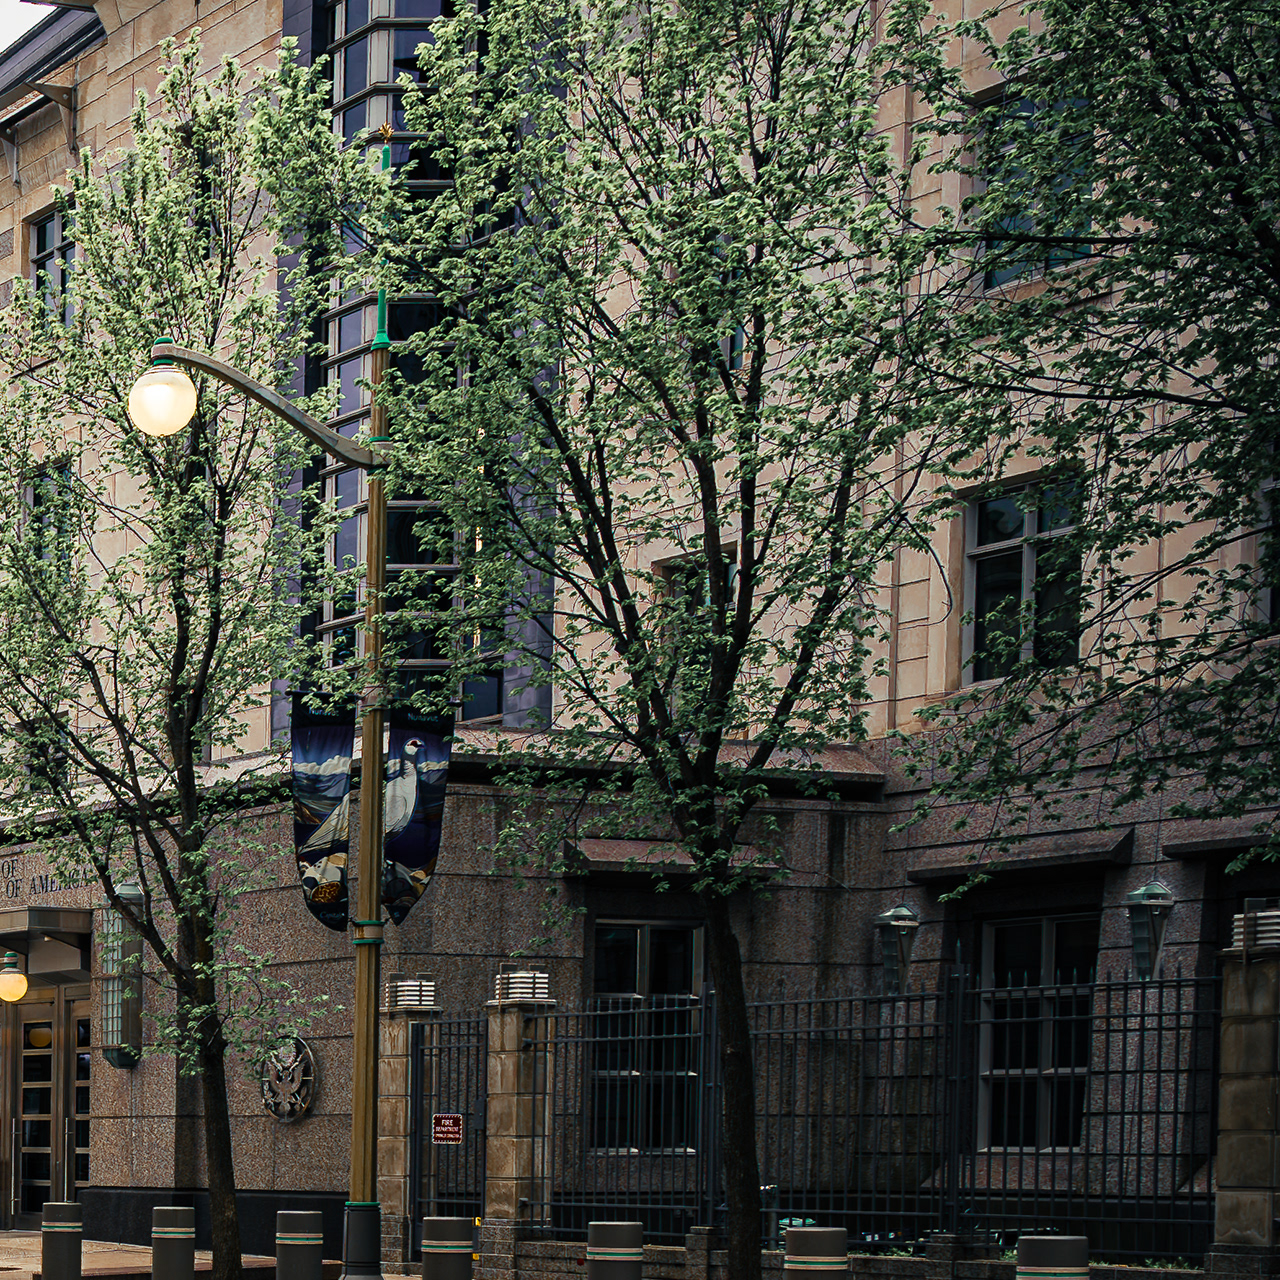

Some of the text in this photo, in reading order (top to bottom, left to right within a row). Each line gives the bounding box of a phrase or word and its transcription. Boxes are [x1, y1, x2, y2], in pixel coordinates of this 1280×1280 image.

[407, 712, 439, 722] Nunavut
[1, 858, 19, 879] OF
[6, 878, 23, 899] OF
